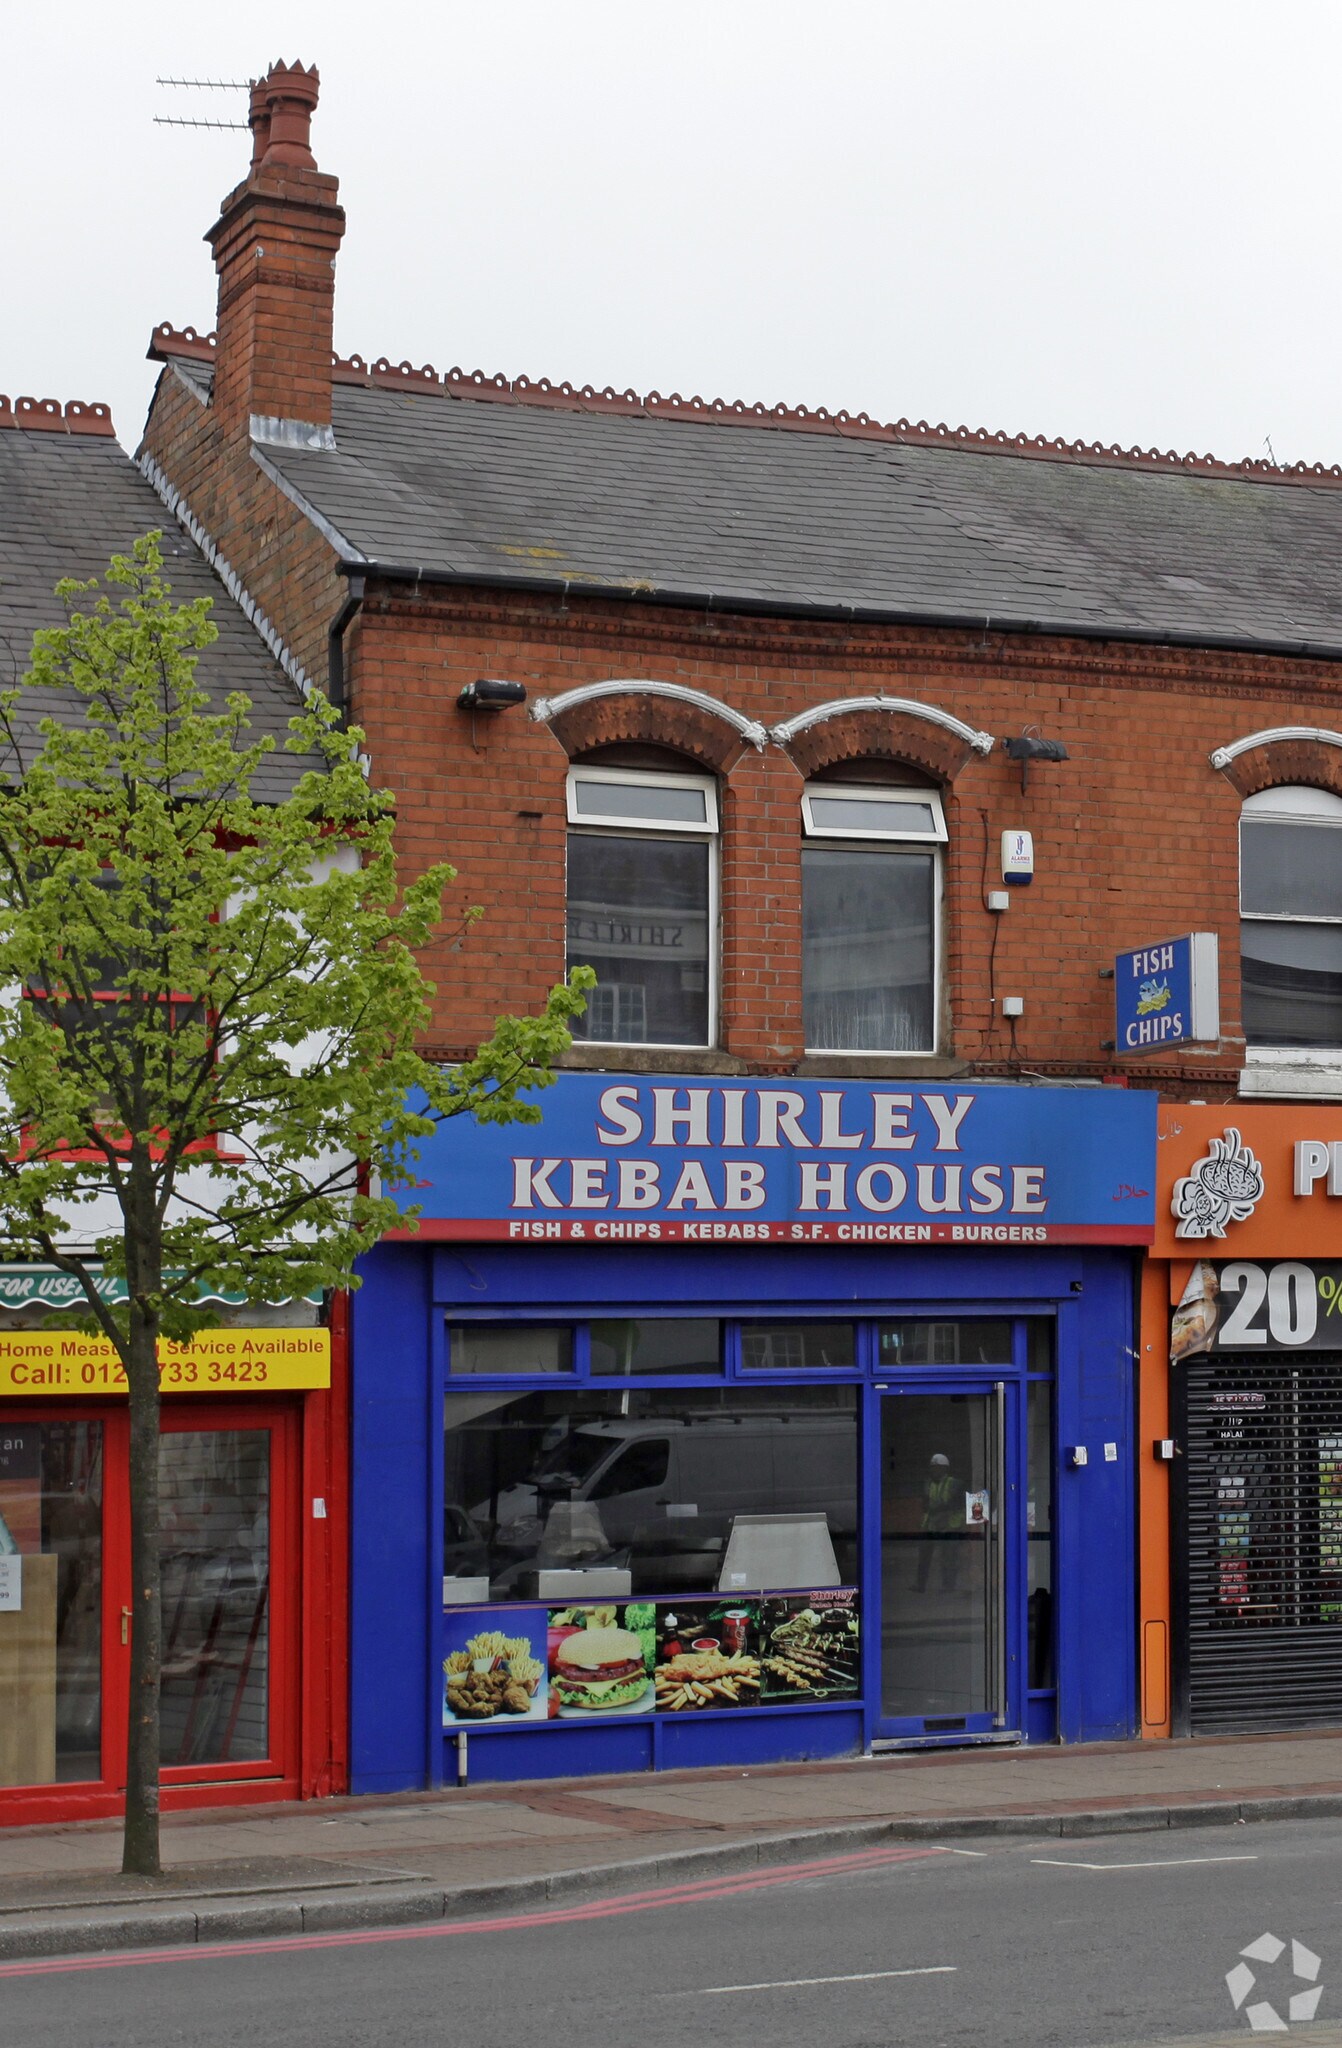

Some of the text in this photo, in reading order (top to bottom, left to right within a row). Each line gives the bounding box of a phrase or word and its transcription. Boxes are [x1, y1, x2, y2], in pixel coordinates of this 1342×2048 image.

[1132, 944, 1174, 978] FISH
[1126, 1012, 1183, 1047] CHIPS
[596, 1084, 976, 1152] SHIRLEY
[510, 1156, 1050, 1214] KEBAB HOUSE
[1294, 1140, 1342, 1196] P
[509, 1222, 562, 1238] FISH
[570, 1222, 586, 1239] &
[594, 1222, 662, 1239] CHIPS
[683, 1223, 771, 1240] KEBABS
[791, 1224, 830, 1240] S.F.
[837, 1225, 931, 1241] CHICKEN
[952, 1226, 1048, 1243] BURGERS
[0, 1342, 54, 1357] Home
[167, 1340, 237, 1355] Service
[241, 1339, 324, 1354] Available
[10, 1362, 70, 1385] Call:
[81, 1362, 128, 1384] 012
[207, 1361, 268, 1382] 3423
